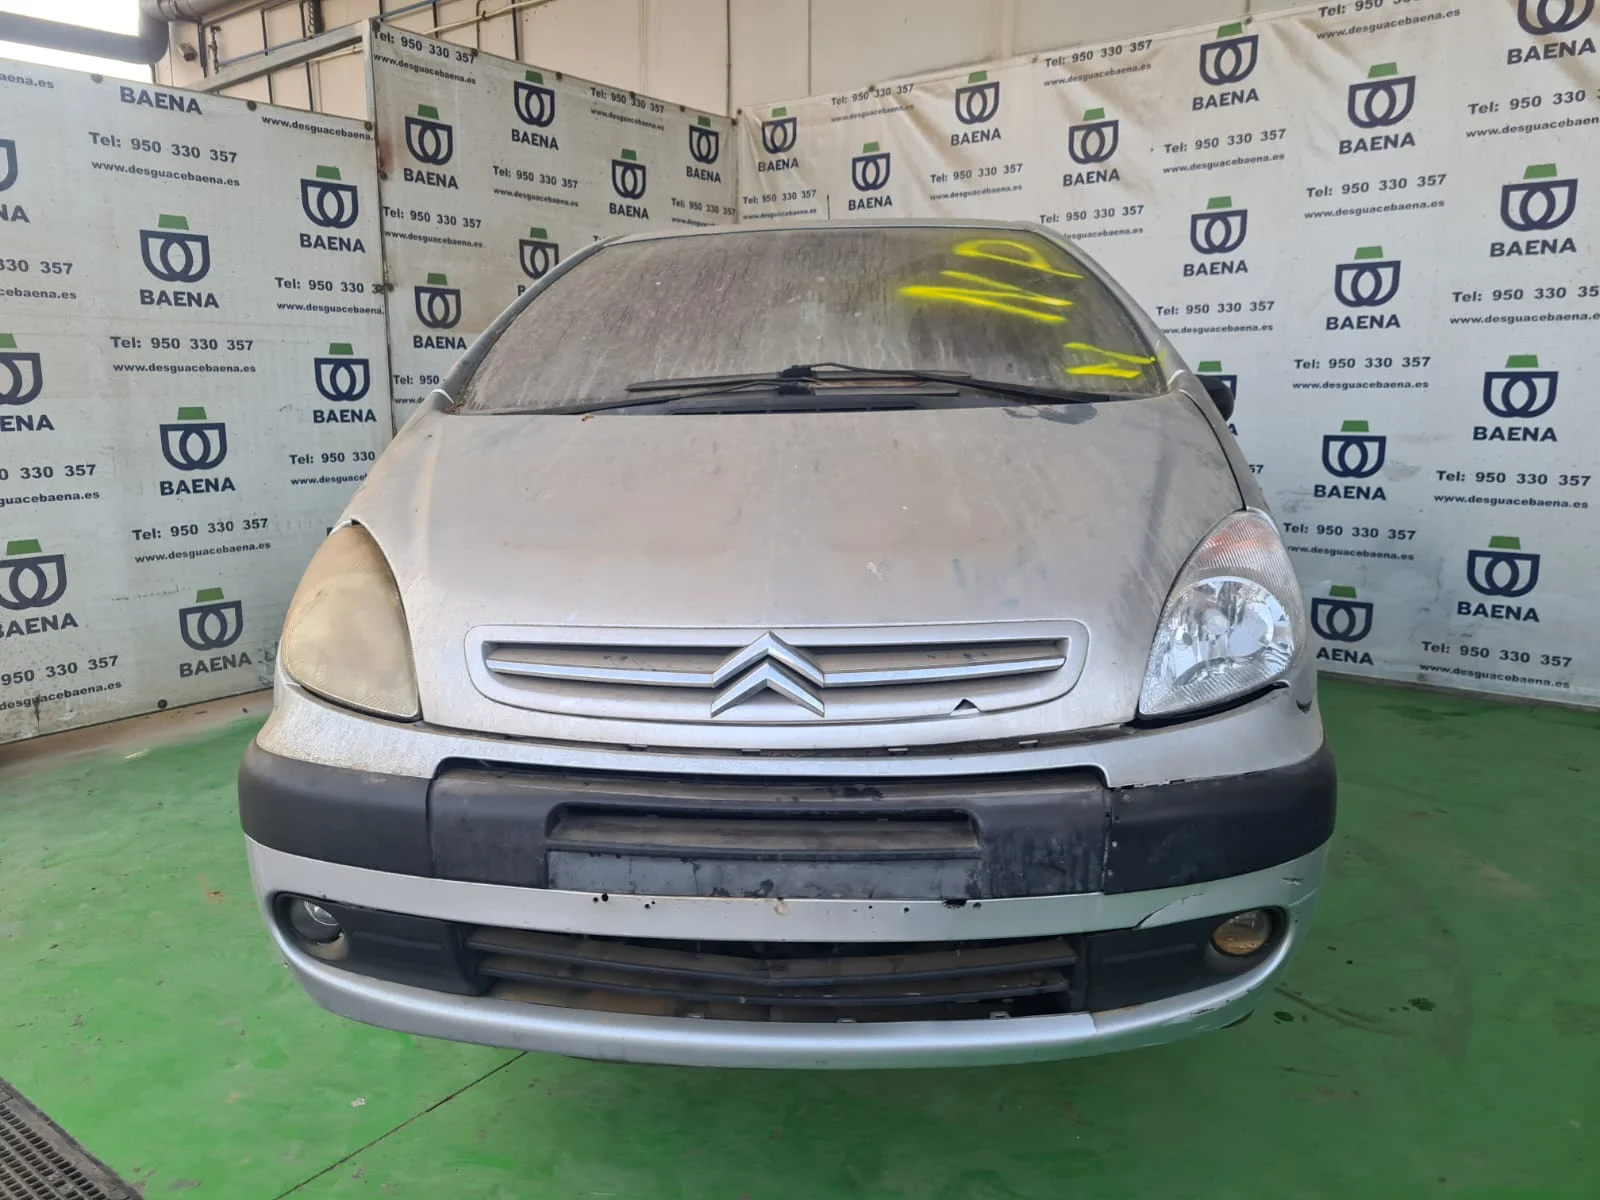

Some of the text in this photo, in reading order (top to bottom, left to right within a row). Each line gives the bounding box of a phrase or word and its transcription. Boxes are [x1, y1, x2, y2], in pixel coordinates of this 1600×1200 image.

[1319, 5, 1345, 17] Tel:
[1355, 0, 1383, 11] 950
[1317, 7, 1460, 39] www.desguacebaena.es
[373, 30, 476, 65] Tel: 950 330 357
[1045, 40, 1152, 67] Tel: 950 330 357
[1507, 38, 1596, 65] BAENA
[373, 52, 476, 85] www.desguacebaena.es
[1044, 62, 1151, 86] www.desguacebaena.es
[120, 86, 202, 115] BAENA
[590, 87, 606, 98] Tel:
[650, 102, 664, 113] 357
[832, 83, 914, 105] Tel: 950 330 357
[1192, 88, 1259, 111] BAENA
[1468, 101, 1499, 114] Tel:
[1510, 96, 1541, 110] 950
[1553, 90, 1585, 105] 330
[512, 129, 558, 150] BAENA
[951, 128, 1001, 146] BAENA
[1164, 129, 1286, 153] Tel: 950 330 357
[1339, 132, 1415, 154] BAENA
[89, 132, 237, 163] Tel: 950 330 357
[92, 160, 240, 186] www.desguacebaena.es
[758, 158, 799, 172] BAENA
[930, 163, 1023, 183] Tel: 950 330 357
[1163, 154, 1284, 173] www.desguacebaena.es
[404, 168, 458, 189] BAENA
[493, 166, 578, 188] Tel: 950 330 357
[686, 166, 721, 183] BAENA
[1063, 168, 1120, 187] BAENA
[1306, 174, 1447, 197] Tel: 950 330 357
[672, 198, 685, 208] Tel:
[743, 196, 758, 204] Tel:
[849, 195, 892, 211] BAENA
[1304, 201, 1444, 218] www.desguacebaena.es
[383, 206, 481, 228] Tel: 950 330 357
[609, 203, 649, 219] BAENA
[1040, 205, 1144, 223] Tel: 950 330 357
[300, 233, 365, 253] BAENA
[384, 230, 482, 248] www.desguacebaena.es
[1490, 238, 1576, 257] BAENA
[40, 261, 72, 275] 357
[1184, 260, 1248, 277] BAENA
[275, 277, 300, 289] Tel:
[309, 280, 333, 291] 950
[341, 282, 364, 293] 330
[1452, 291, 1482, 302] Tel:
[1493, 289, 1523, 301] 950
[1534, 287, 1566, 299] 330
[140, 289, 219, 308] BAENA
[1156, 301, 1274, 315] Tel: 950 330 357
[1326, 314, 1400, 330] BAENA
[110, 336, 253, 351] Tel: 950 330 357
[413, 335, 466, 349] BAENA
[113, 363, 256, 374] www.desguacebaena.es
[1294, 357, 1431, 369] Tel: 950 330 357
[393, 375, 439, 384] Tel: 950
[1292, 381, 1428, 390] www.desguacebaena.es
[313, 409, 376, 423] BAENA
[1473, 426, 1557, 442] BAENA
[289, 451, 375, 464] Tel: 950 330
[20, 467, 53, 479] 330
[65, 464, 96, 477] 357
[1436, 471, 1591, 486] Tel: 950 330 357
[160, 477, 235, 496] BAENA
[1314, 485, 1386, 500] BAENA
[1434, 496, 1588, 508] www.desguacebaena.es
[132, 518, 268, 540] Tel: 950 330 357
[1283, 523, 1416, 540] Tel: 950 330 357
[135, 543, 270, 563] www.desguacebaena.es
[1457, 601, 1539, 622] BAENA
[0, 612, 78, 639] AENA
[1422, 641, 1572, 667] Tel: 950 330 357
[1, 655, 118, 685] 950 330 357
[179, 652, 252, 678] BAENA
[1419, 662, 1569, 688] www.desguacebaena.es
